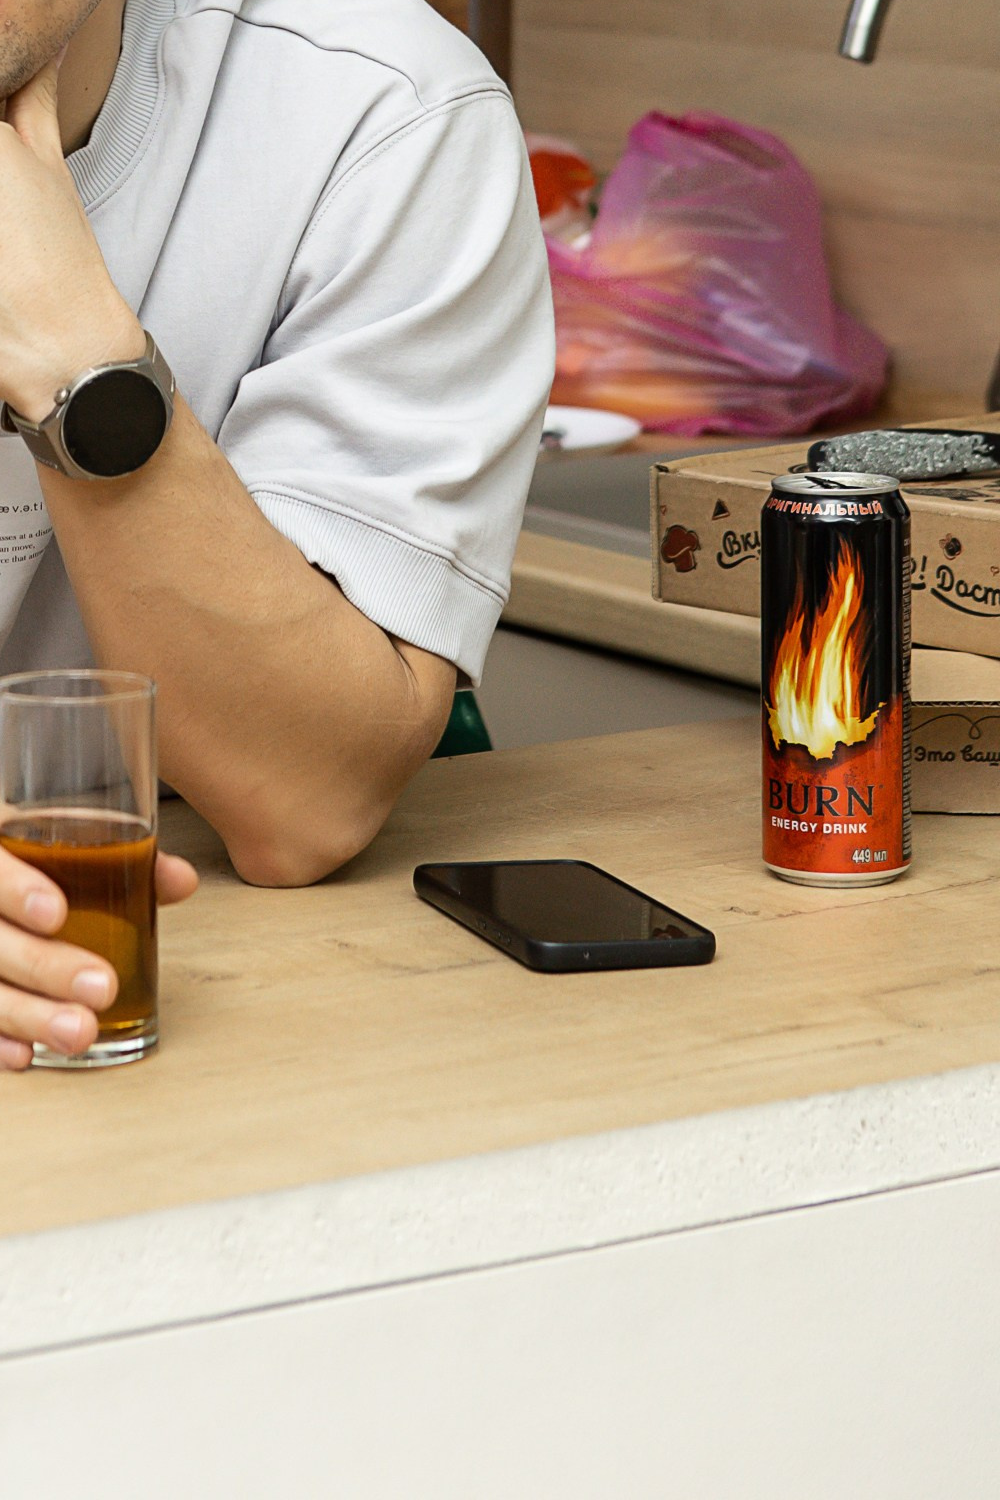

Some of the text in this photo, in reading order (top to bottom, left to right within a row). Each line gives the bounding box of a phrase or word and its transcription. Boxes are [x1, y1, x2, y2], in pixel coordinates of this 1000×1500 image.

[766, 498, 884, 516] ОРИГИНАЛЬНЫЙ
[11, 555, 27, 563] that
[914, 745, 956, 762] Это
[768, 778, 875, 818] BURN
[771, 815, 868, 834] ENERGY DRINK
[852, 848, 871, 863] 449
